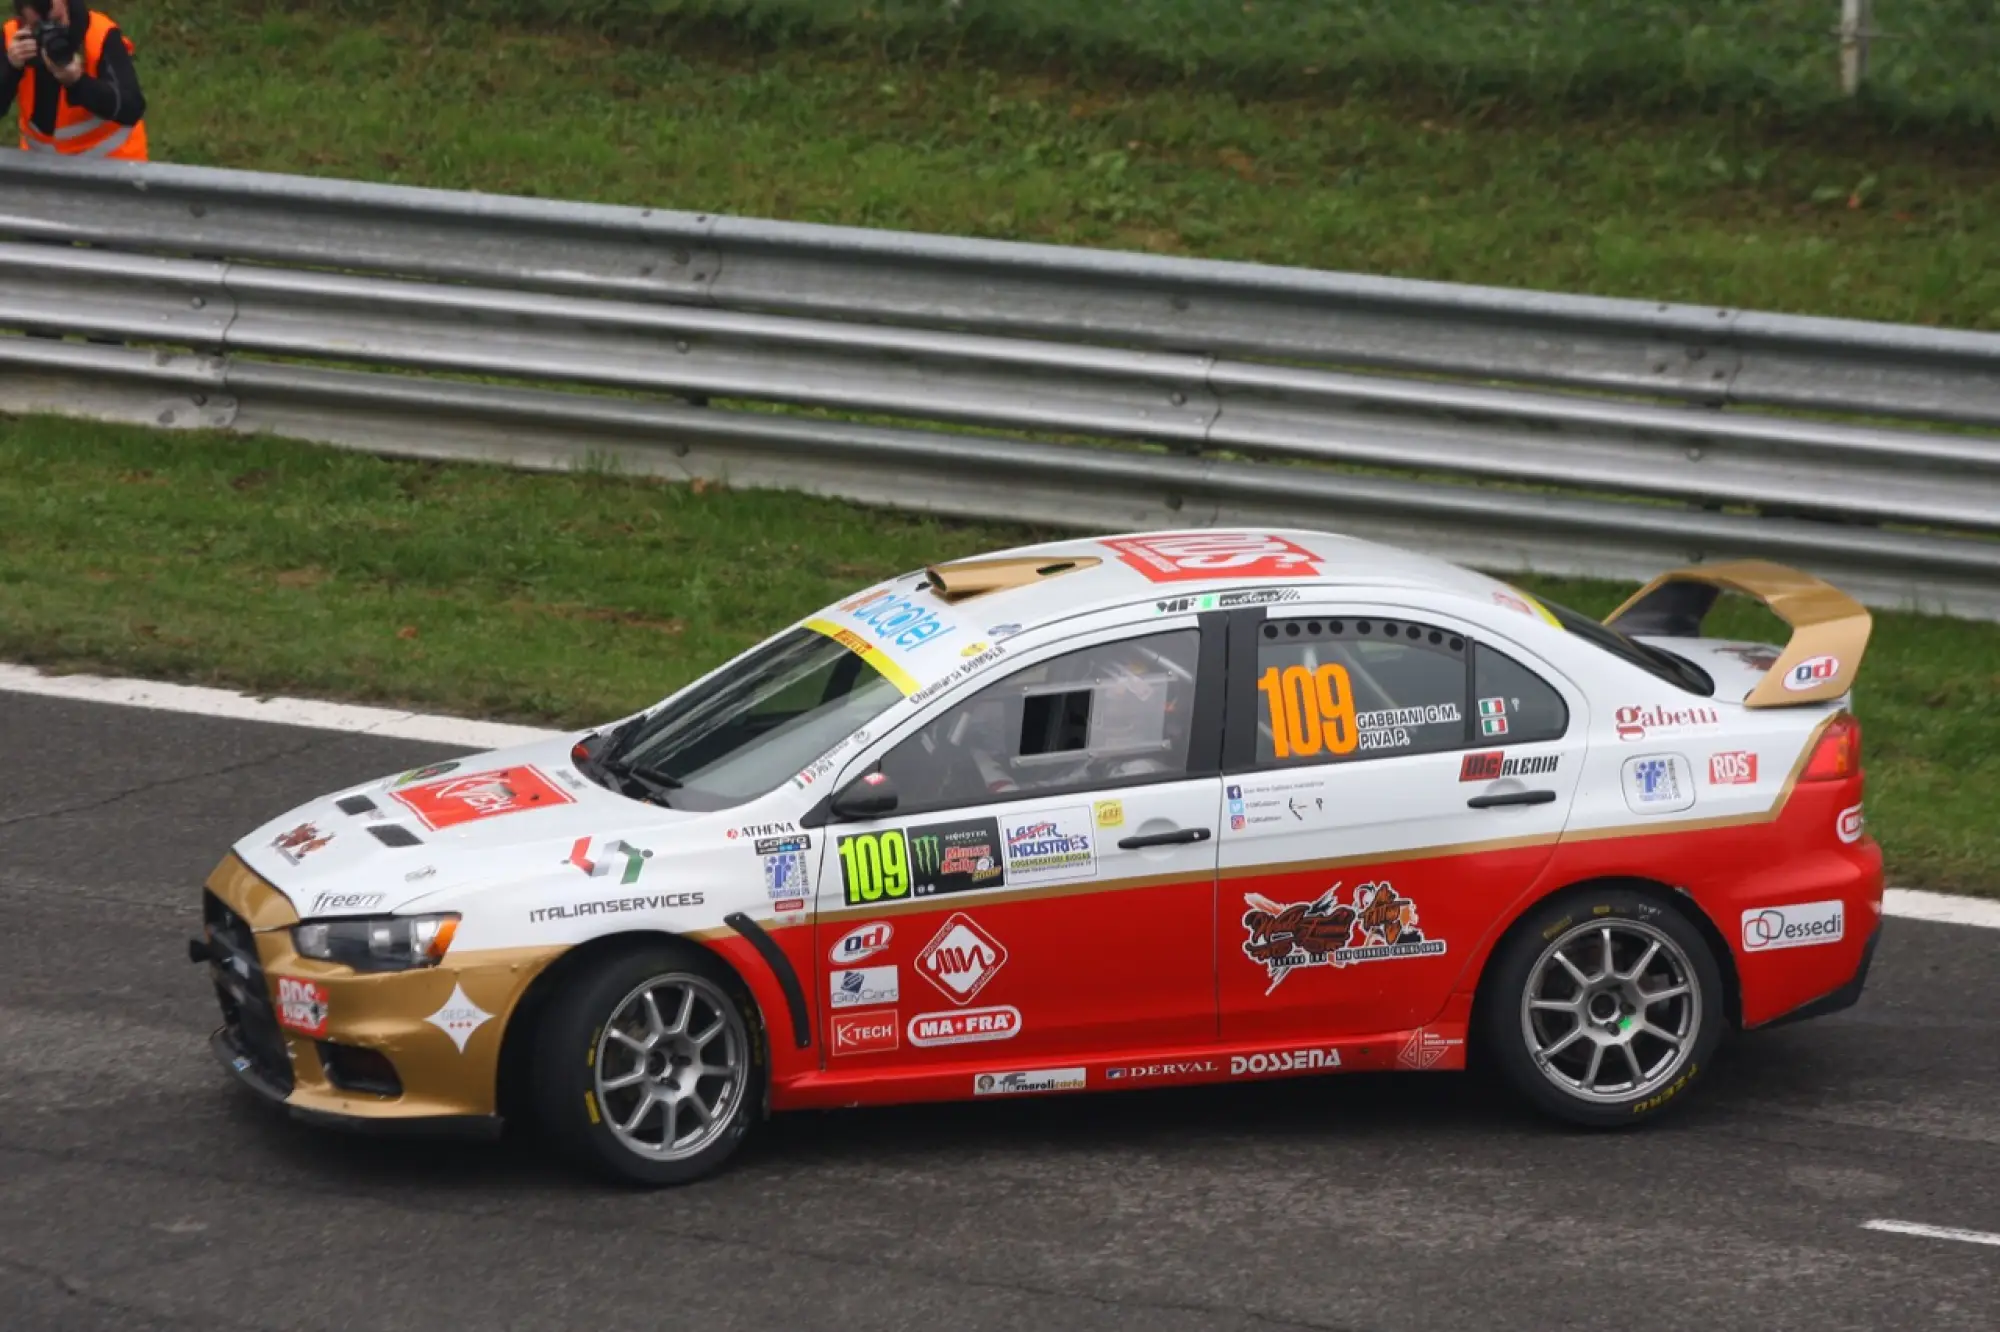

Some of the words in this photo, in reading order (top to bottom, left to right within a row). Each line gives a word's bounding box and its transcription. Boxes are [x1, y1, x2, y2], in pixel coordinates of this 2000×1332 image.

[1258, 663, 1358, 759] 109
[1357, 706, 1425, 730] GABBIANI
[1615, 704, 1720, 742] gabetti
[1359, 729, 1394, 749] PIVA
[1393, 727, 1412, 747] P.
[1711, 752, 1750, 779] RDS
[741, 822, 795, 838] ATHENA
[1008, 834, 1089, 858] INDUSTRIES
[839, 831, 908, 902] 109
[312, 892, 384, 913] freem
[529, 891, 705, 924] ITALIANSERVICES
[1130, 1061, 1220, 1078] DERVAL
[1231, 1047, 1342, 1076] DOSSENA
